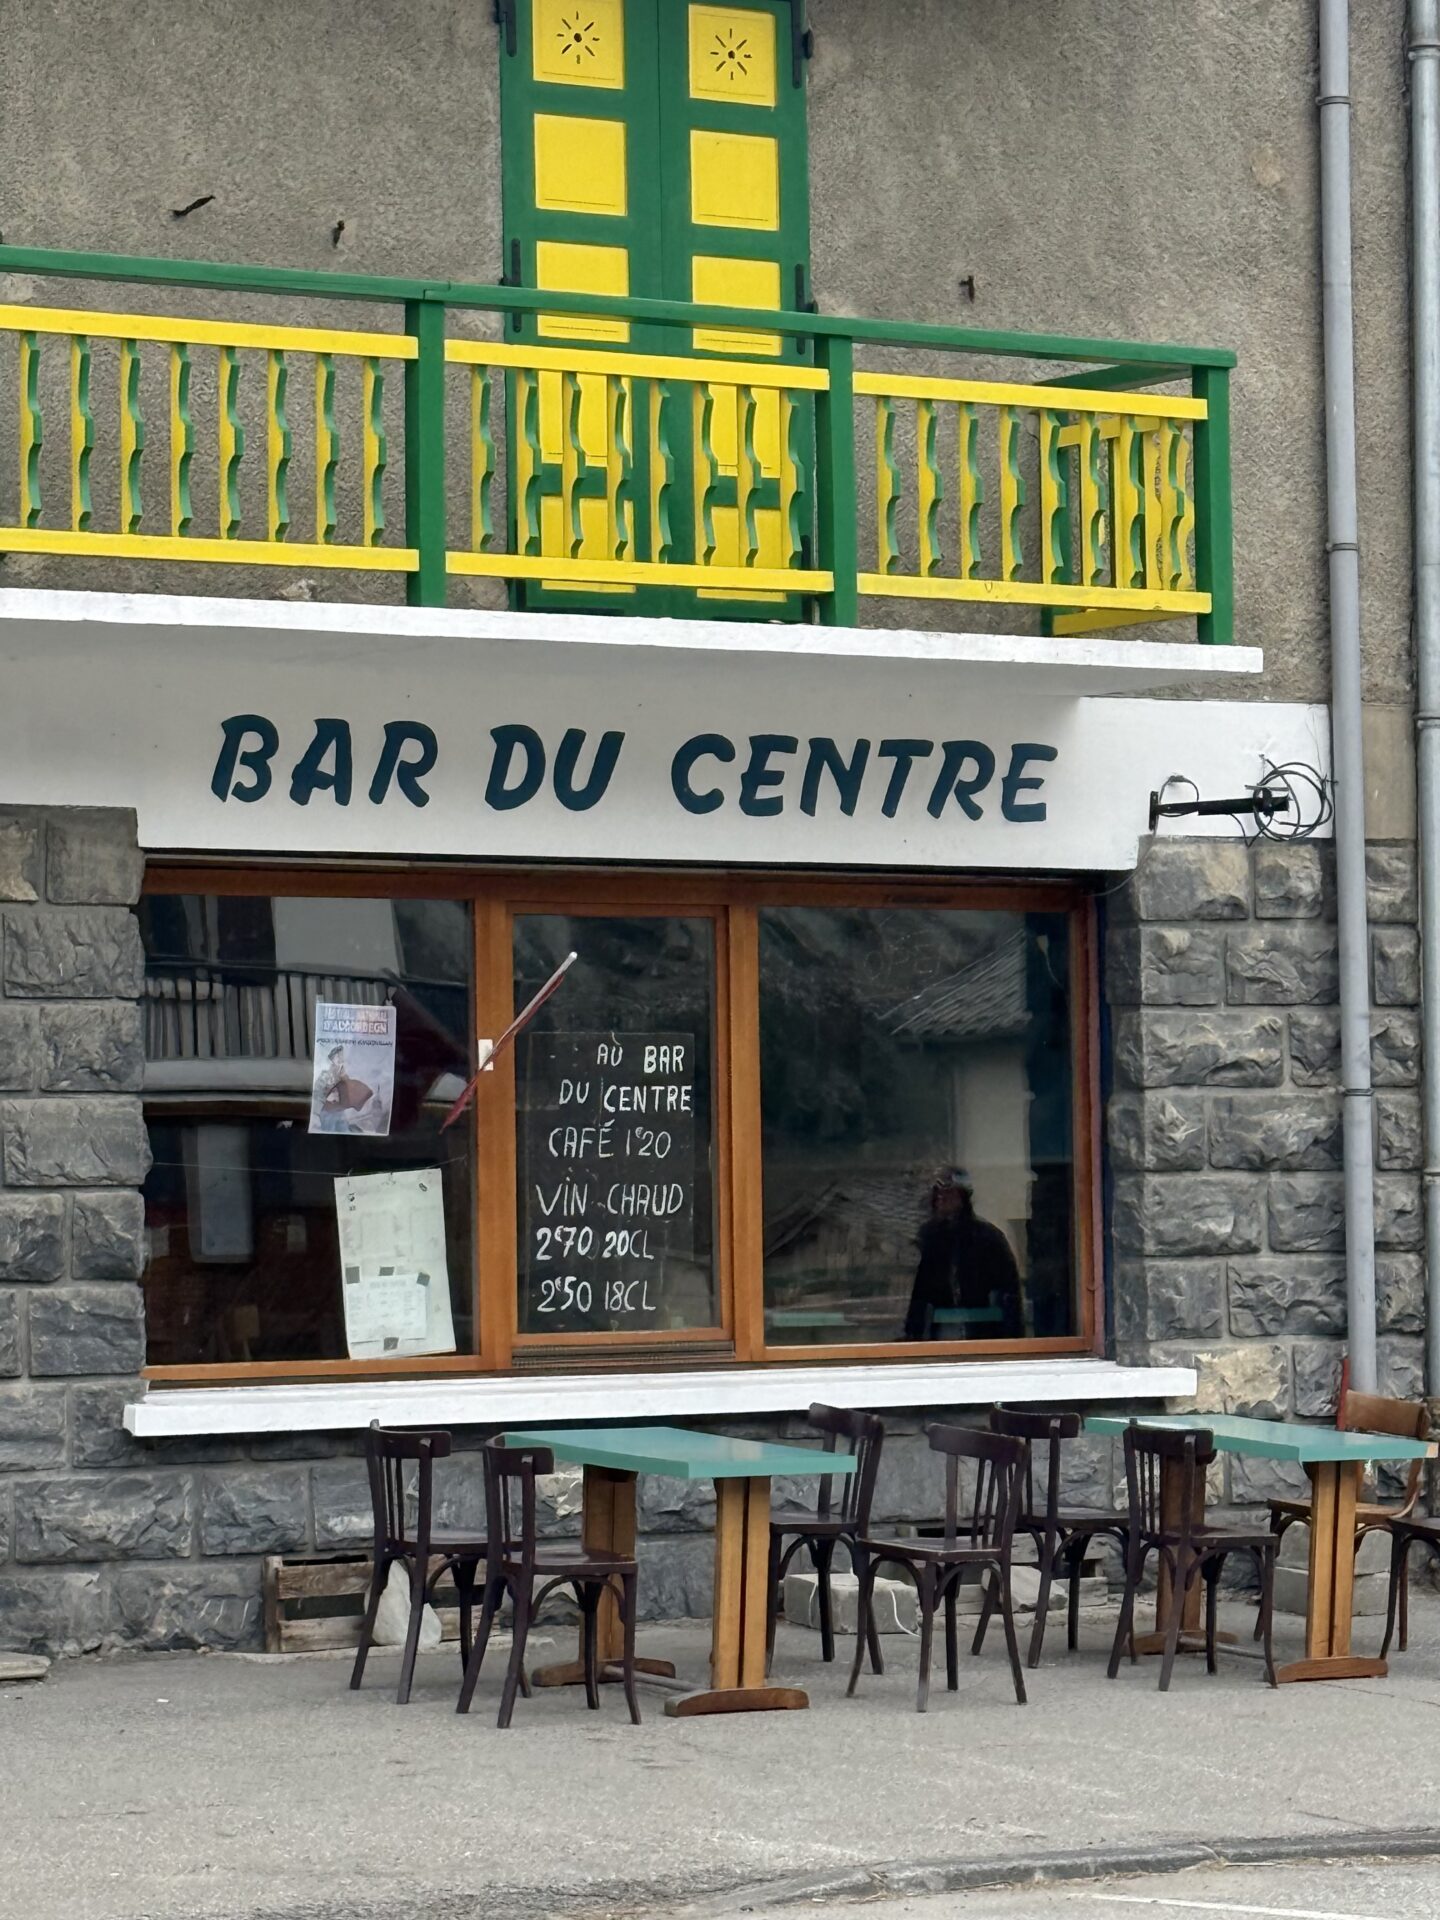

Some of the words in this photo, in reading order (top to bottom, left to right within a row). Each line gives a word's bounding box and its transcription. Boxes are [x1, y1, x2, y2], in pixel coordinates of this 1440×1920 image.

[211, 714, 438, 808] BAR
[485, 723, 625, 812] DU
[671, 734, 1058, 823] CENTRE
[597, 1043, 623, 1067] AU
[643, 1045, 685, 1074] BAR
[558, 1079, 590, 1105] DU
[603, 1085, 692, 1112] CENTRE
[548, 1119, 615, 1159] CAFÉ
[607, 1183, 683, 1216] CHAUD
[602, 1228, 654, 1260] 20CL
[605, 1280, 656, 1312] 18CL
